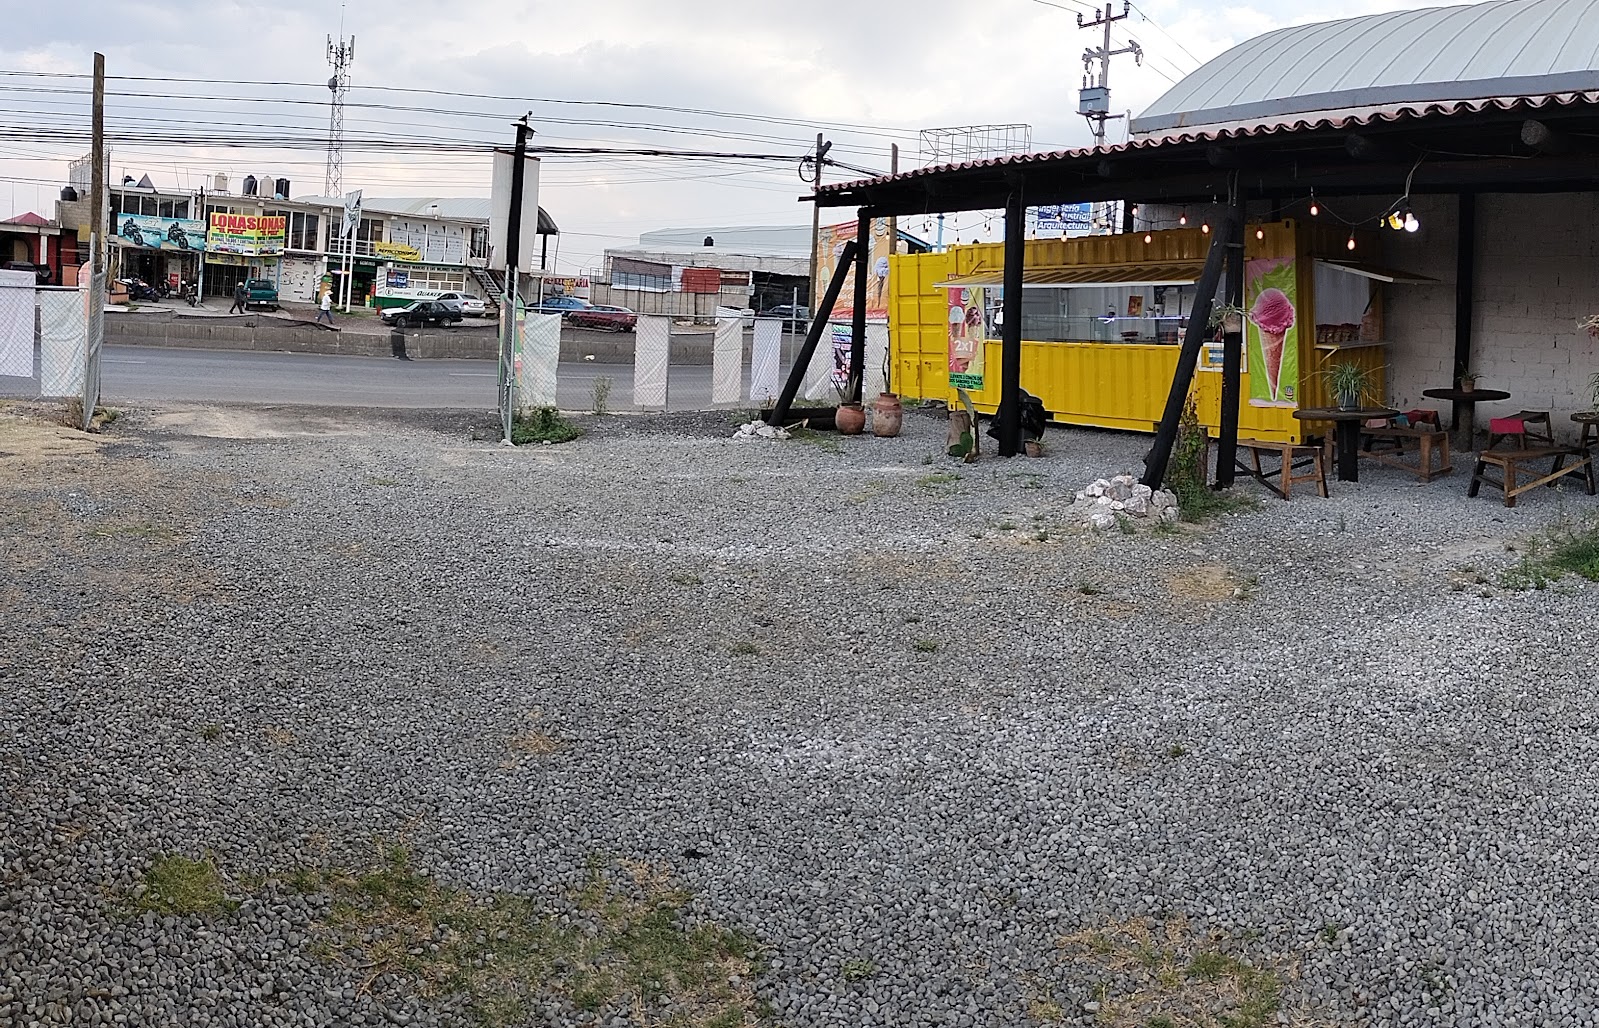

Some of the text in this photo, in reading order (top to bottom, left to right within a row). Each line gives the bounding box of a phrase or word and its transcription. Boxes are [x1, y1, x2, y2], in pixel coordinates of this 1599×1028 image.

[211, 214, 256, 230] LONAS
[257, 217, 285, 230] LONAS
[1038, 222, 1089, 230] Arquitectura
[954, 340, 973, 352] 2x1
